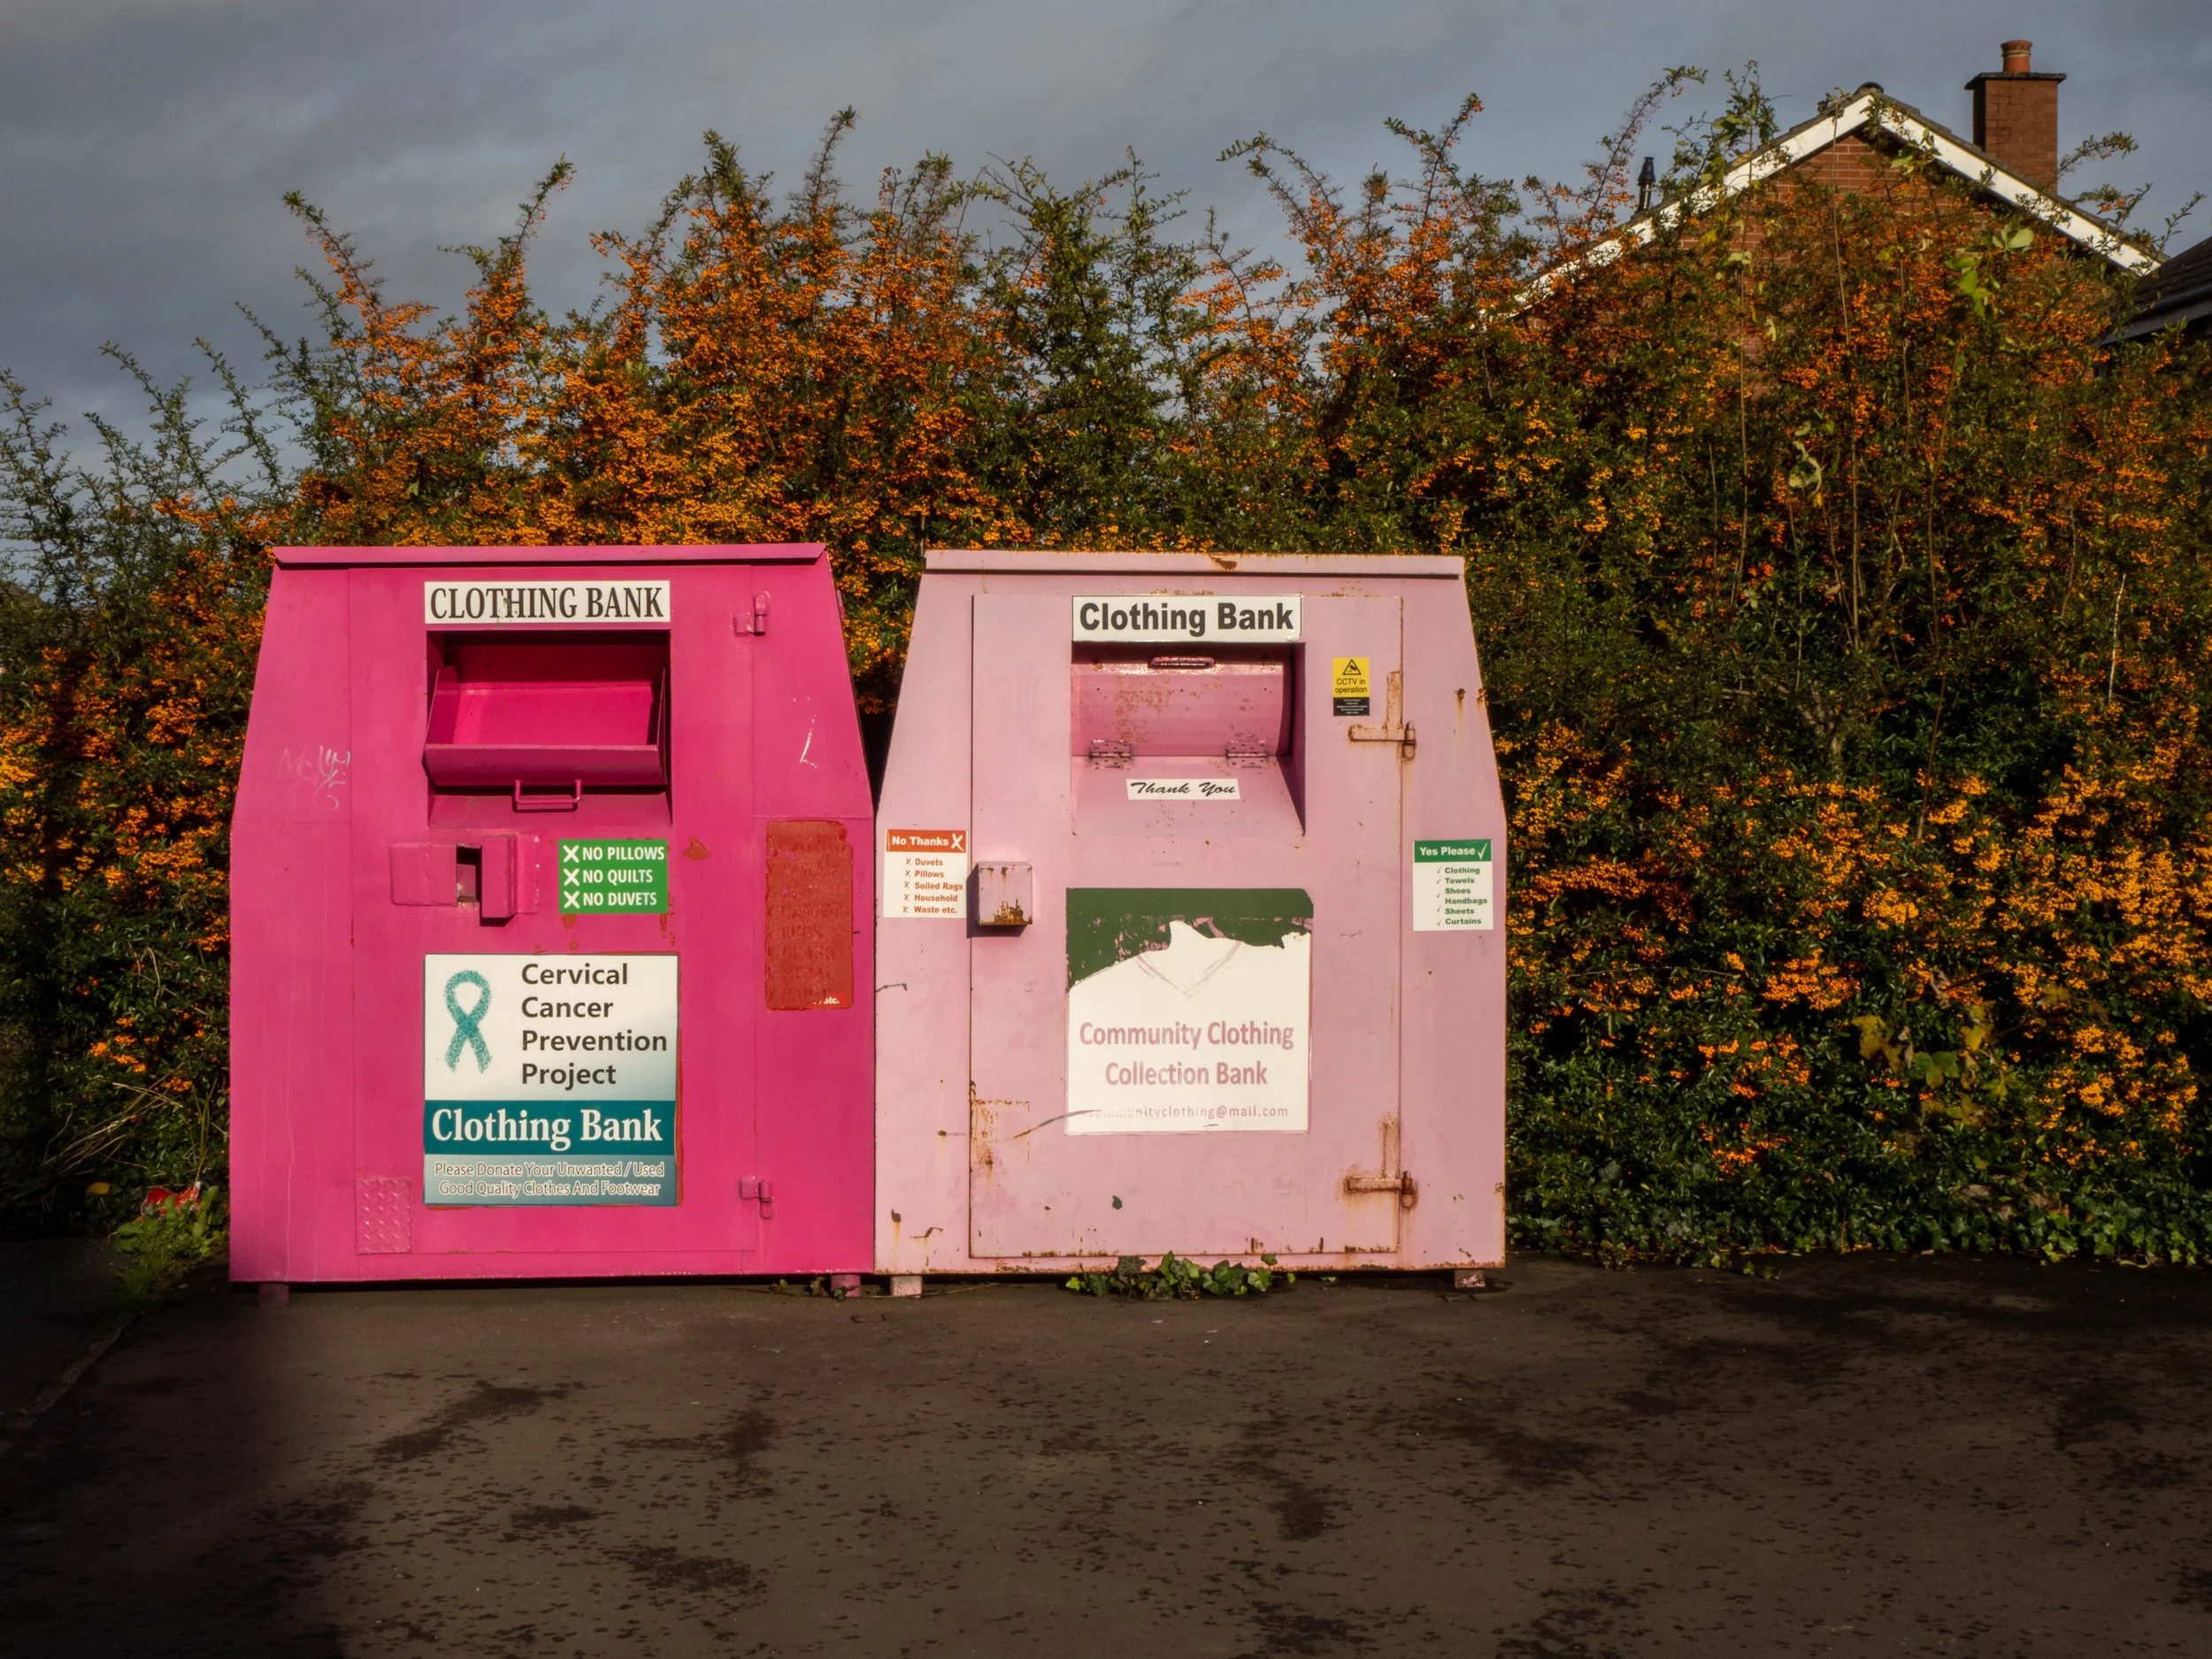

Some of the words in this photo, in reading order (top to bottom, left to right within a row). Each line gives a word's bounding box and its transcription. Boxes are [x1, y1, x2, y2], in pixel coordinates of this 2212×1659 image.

[430, 588, 578, 618] CLOTHING
[586, 588, 664, 618] BANK
[1079, 603, 1206, 637] Clothing
[1217, 603, 1294, 630] Bank
[1130, 781, 1191, 795] Thank
[1198, 782, 1236, 797] You
[891, 835, 907, 846] No
[910, 836, 949, 847] Thanks
[582, 847, 603, 860] NO
[607, 847, 665, 860] PILLOWS
[1419, 847, 1438, 856] Yes
[1440, 846, 1476, 856] Please
[914, 857, 943, 866] Duvets
[582, 870, 603, 883] NO
[607, 869, 653, 886] QUILTS
[914, 870, 945, 879] Pillows
[942, 882, 964, 892] Rags
[582, 892, 603, 906] NO
[608, 892, 657, 906] DUVETS
[913, 905, 940, 914] Waste
[941, 905, 958, 914] etc.
[521, 963, 628, 985] Cervical
[521, 996, 614, 1018] Cancer
[521, 1029, 668, 1051] Prevention
[1079, 1021, 1202, 1050] Community
[1207, 1020, 1294, 1050] Clothing
[521, 1063, 617, 1090] Project
[1105, 1061, 1210, 1086] Collection
[1216, 1060, 1268, 1086] Bank
[432, 1108, 572, 1152] Clothing
[580, 1108, 664, 1141] Bank
[434, 1162, 474, 1177] Please
[476, 1162, 523, 1177] Donate
[524, 1162, 555, 1177] Your
[557, 1162, 623, 1177] Unwanted
[624, 1162, 634, 1177] /
[633, 1162, 664, 1177] Used
[439, 1180, 475, 1196] Good
[476, 1180, 521, 1199] Quality
[523, 1180, 570, 1196] Clothes
[572, 1180, 598, 1196] And
[600, 1180, 661, 1196] Footwear
